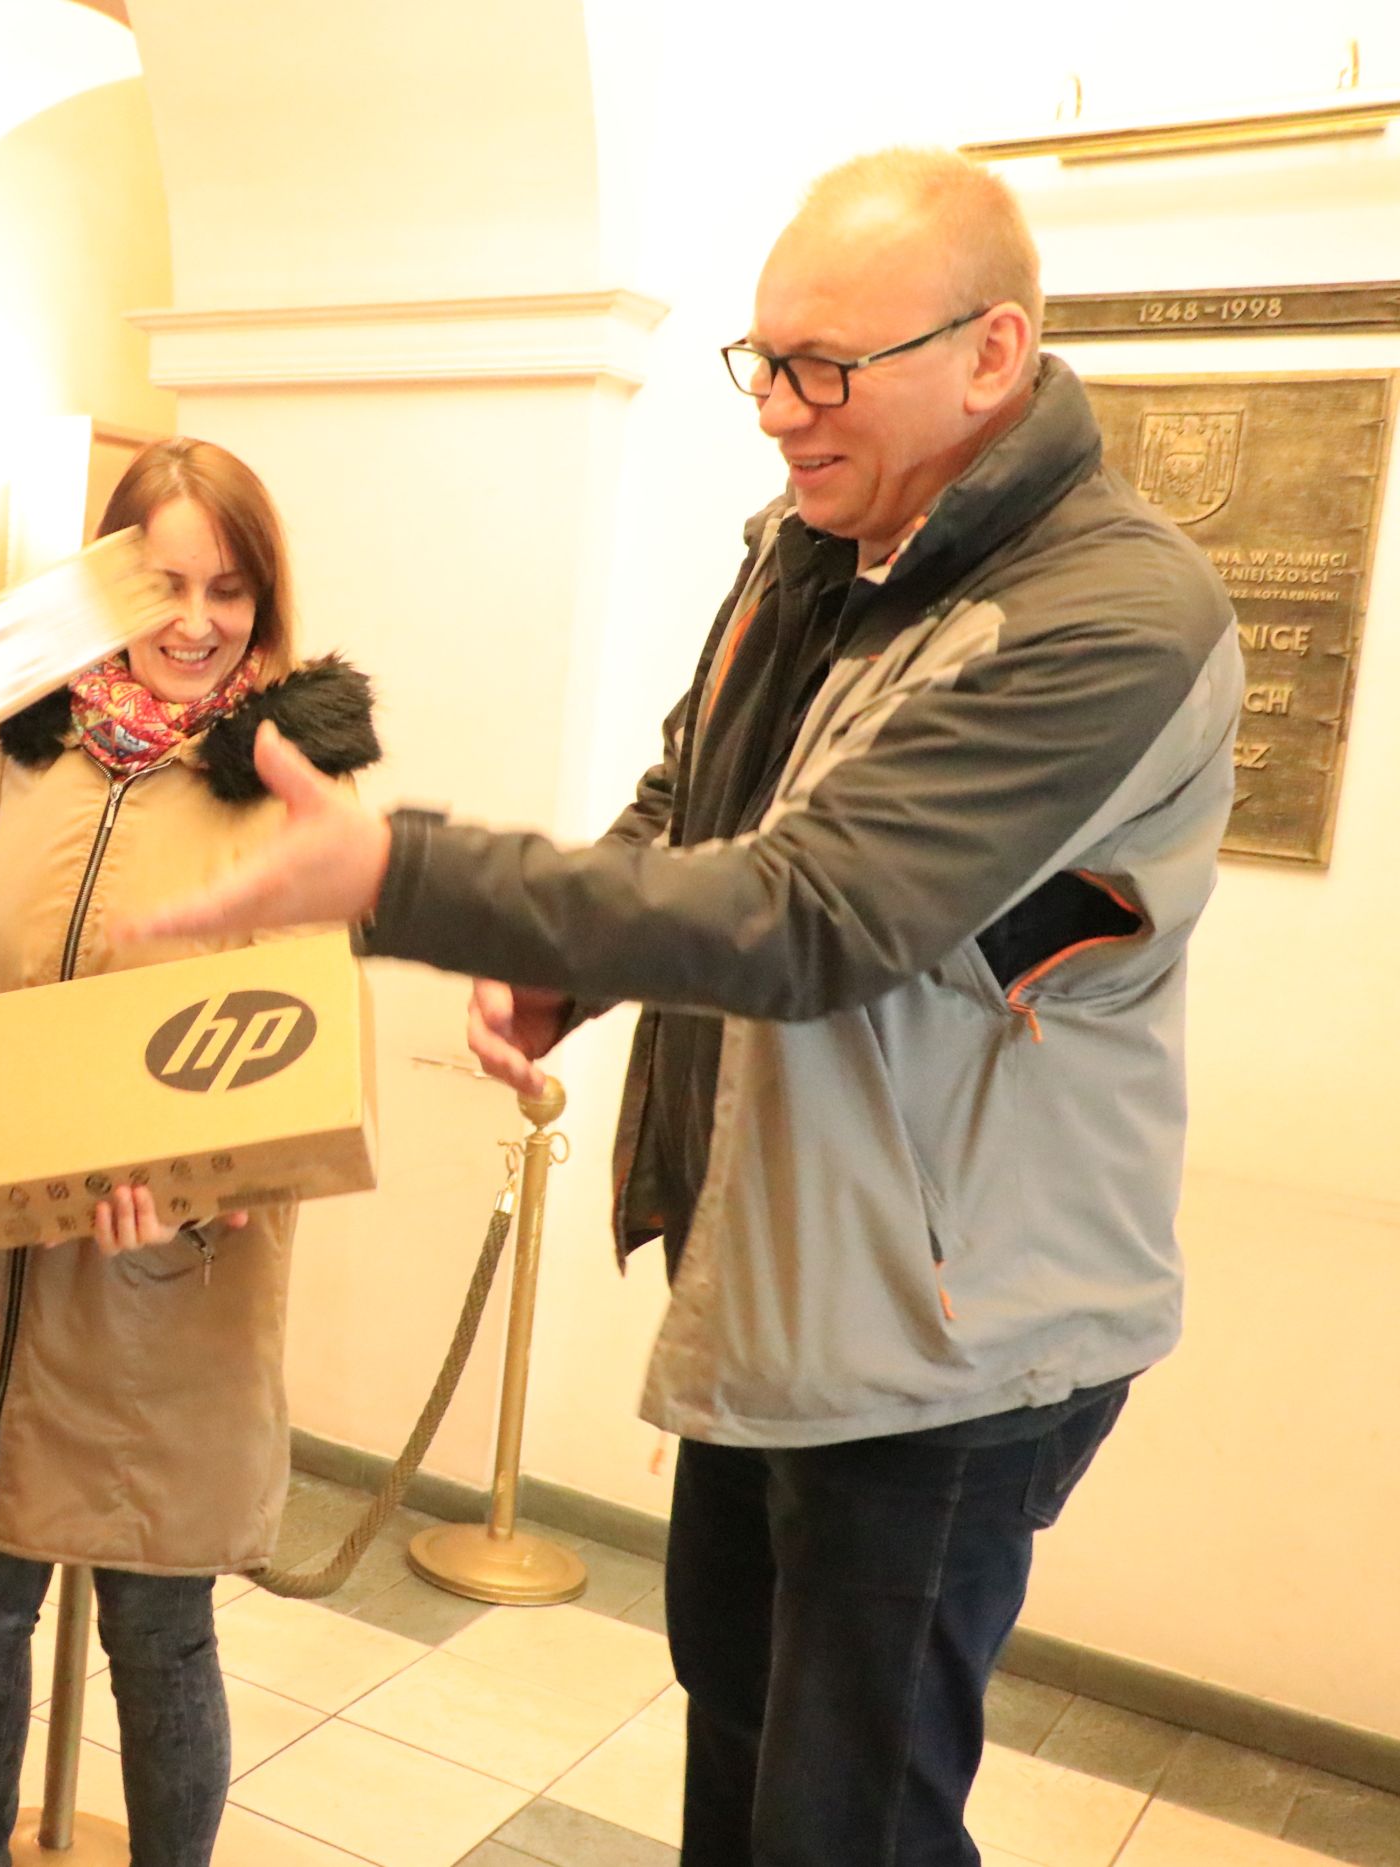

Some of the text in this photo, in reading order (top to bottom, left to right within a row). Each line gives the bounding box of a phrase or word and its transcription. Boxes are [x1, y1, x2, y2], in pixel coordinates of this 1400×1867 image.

[1138, 297, 1283, 323] 1248-1998
[1250, 552, 1269, 566] W
[155, 991, 307, 1094] hp
